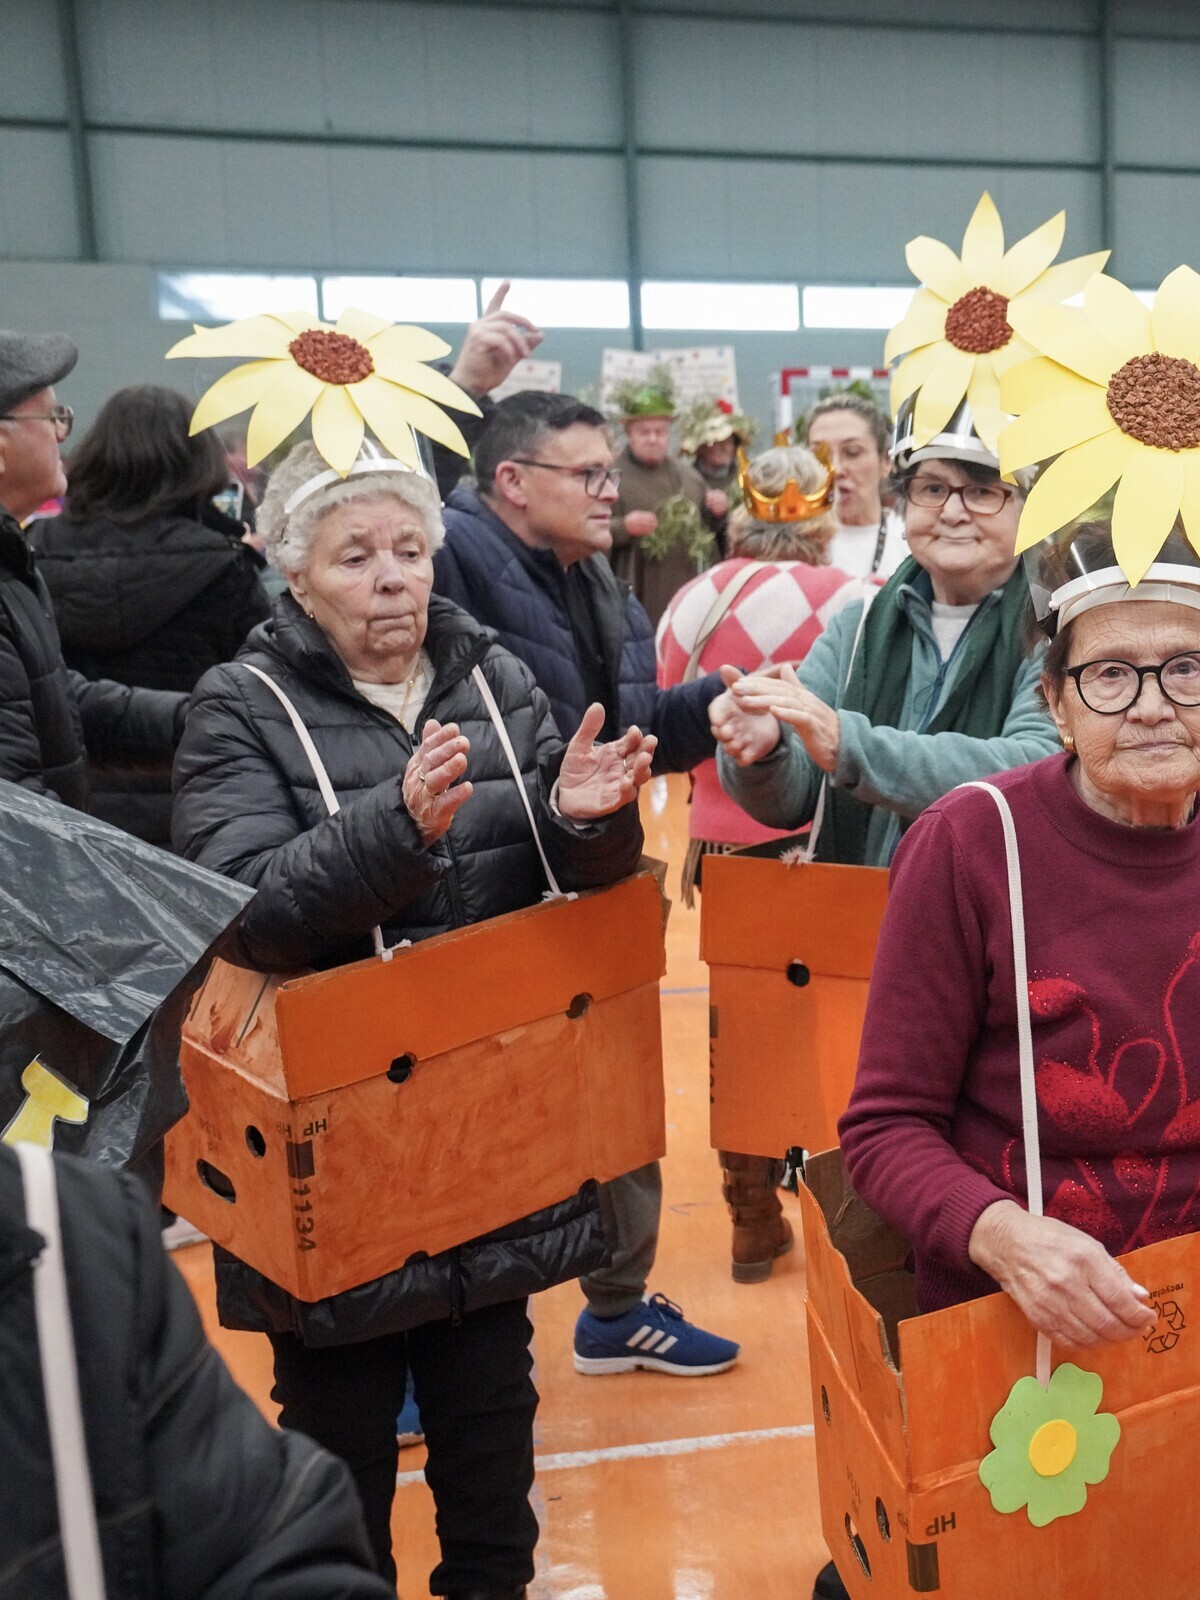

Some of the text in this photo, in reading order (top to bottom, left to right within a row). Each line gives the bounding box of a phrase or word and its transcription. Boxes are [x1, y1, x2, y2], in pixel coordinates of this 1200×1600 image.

[303, 1118, 327, 1136] HP
[294, 1184, 316, 1251] 1134
[925, 1511, 957, 1537] HP
